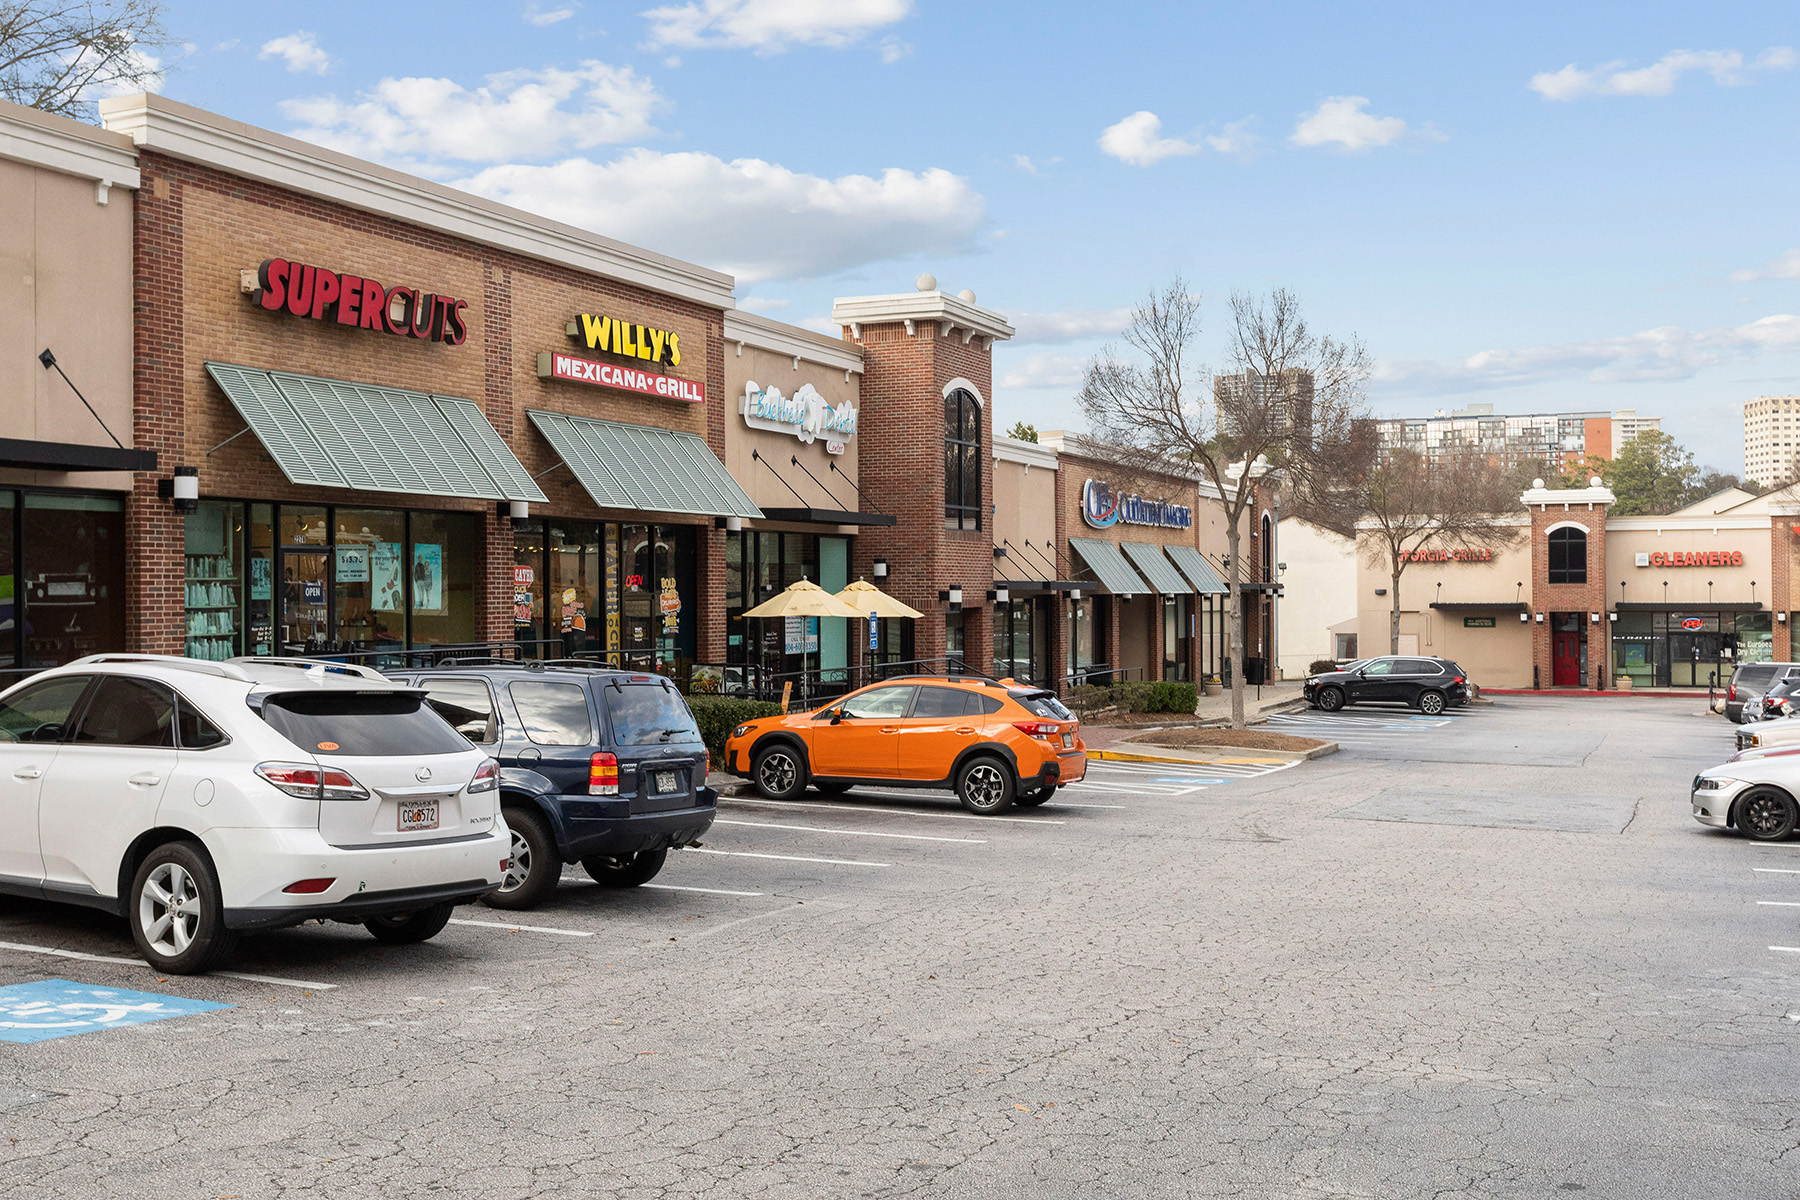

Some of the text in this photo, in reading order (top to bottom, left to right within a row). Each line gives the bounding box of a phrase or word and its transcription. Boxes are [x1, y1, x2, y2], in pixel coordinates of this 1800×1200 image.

[260, 257, 469, 346] SUPERCUTS
[580, 312, 682, 367] WILLY'S
[655, 376, 703, 402] GRILL
[825, 405, 858, 434] Dental
[1397, 548, 1492, 562] GEORGIA GRILLE
[1650, 550, 1744, 567] CLEANERS
[625, 574, 643, 588] OPEN
[304, 586, 321, 597] OPEN
[1681, 619, 1704, 629] OPEN
[1736, 648, 1748, 656] Dry
[1747, 640, 1772, 649] Europea
[402, 807, 436, 823] CGL8572
